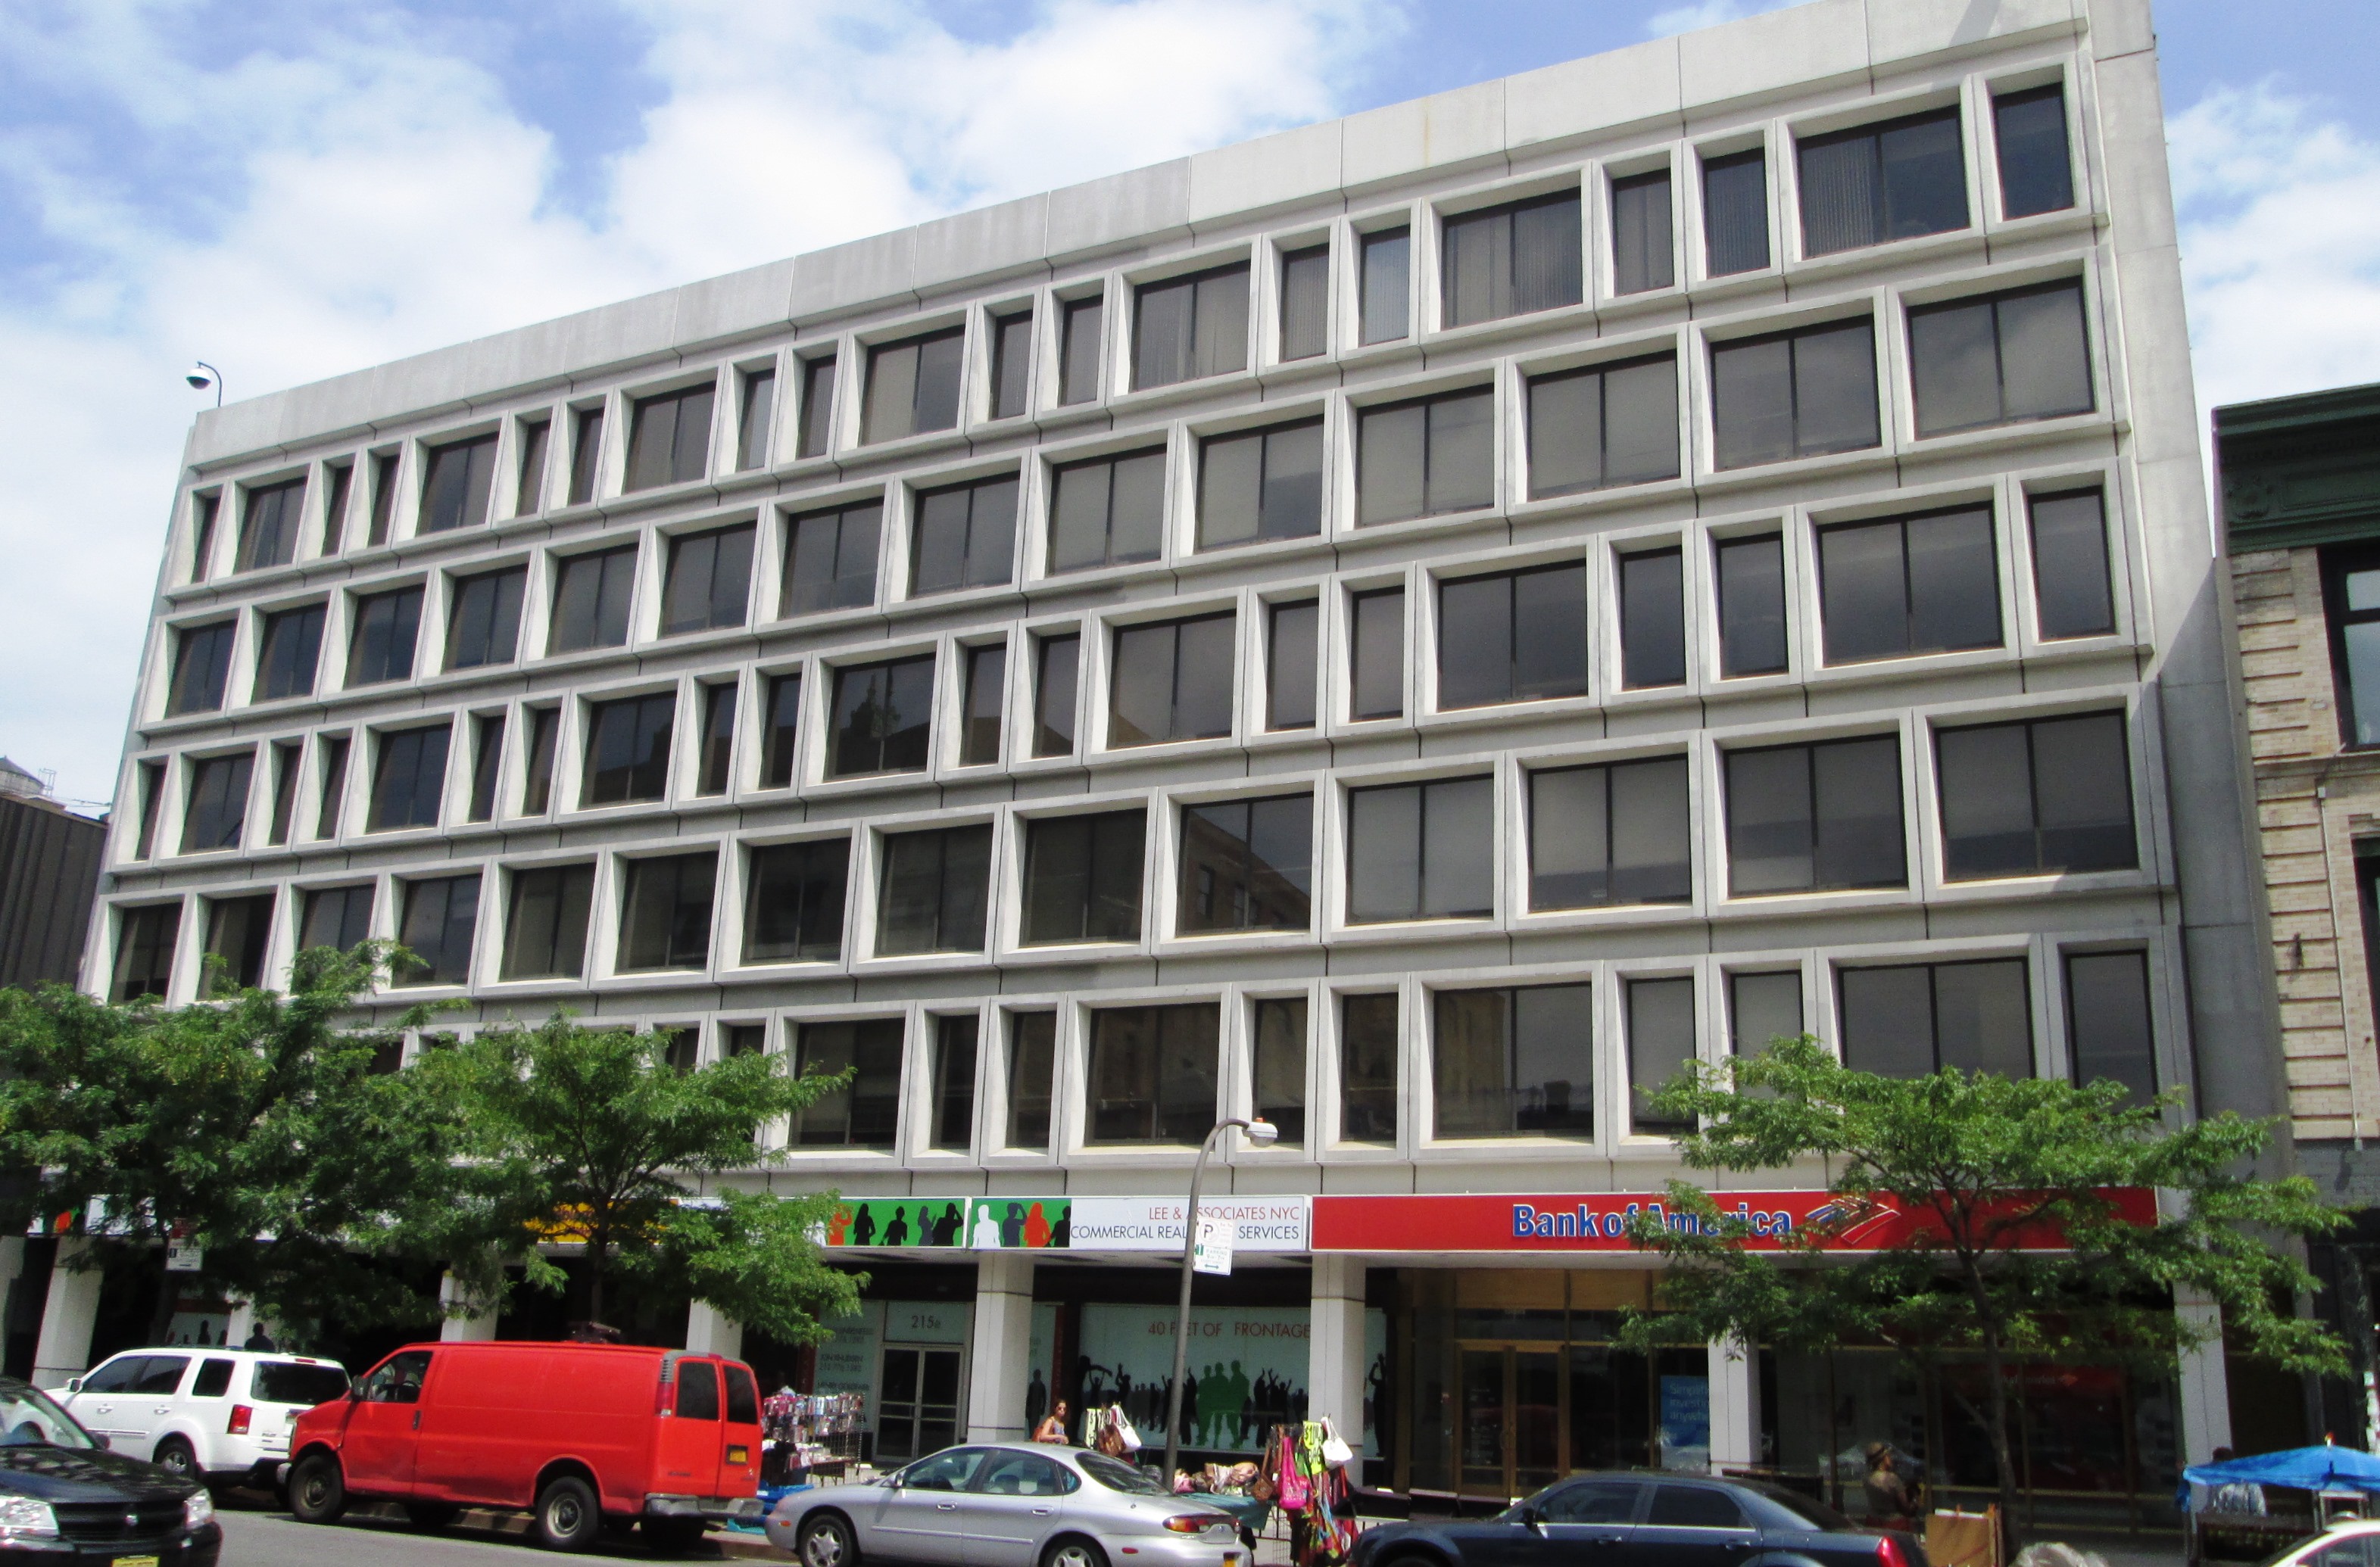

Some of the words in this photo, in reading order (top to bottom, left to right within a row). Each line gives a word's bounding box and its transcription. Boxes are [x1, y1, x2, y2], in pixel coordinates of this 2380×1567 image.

[1149, 1207, 1168, 1220] LEE
[1172, 1207, 1182, 1220] &
[1187, 1206, 1266, 1220] SSOCIATES
[1270, 1207, 1299, 1220] NYC
[1512, 1204, 1599, 1237] Bank
[1070, 1225, 1154, 1239] COMMERCIAL
[1157, 1226, 1187, 1239] REAL
[1237, 1226, 1299, 1240] SERVICES
[1148, 1321, 1166, 1336] 40
[1170, 1322, 1199, 1337] FET
[1202, 1322, 1223, 1338] OF
[1234, 1322, 1311, 1339] FRONTAGE
